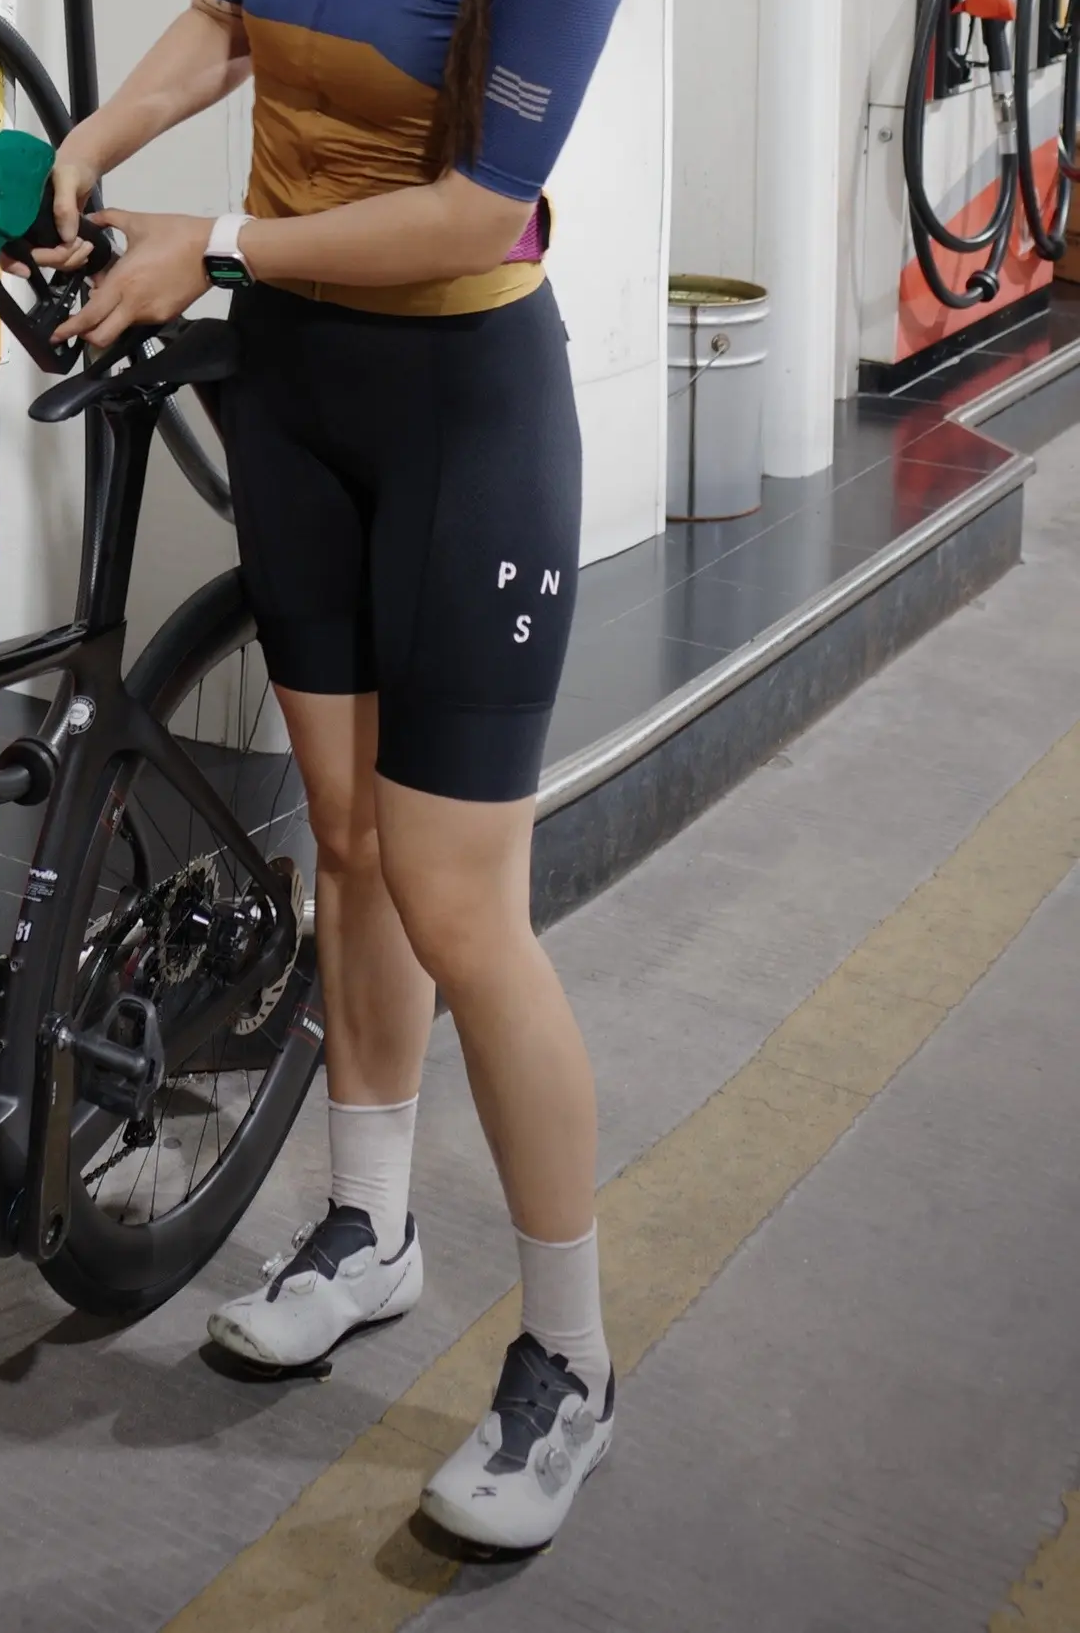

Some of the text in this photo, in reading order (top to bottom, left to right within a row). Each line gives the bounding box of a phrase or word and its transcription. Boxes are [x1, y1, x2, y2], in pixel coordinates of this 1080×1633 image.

[497, 561, 561, 596] P N
[513, 614, 532, 644] S
[15, 919, 33, 943] 51
